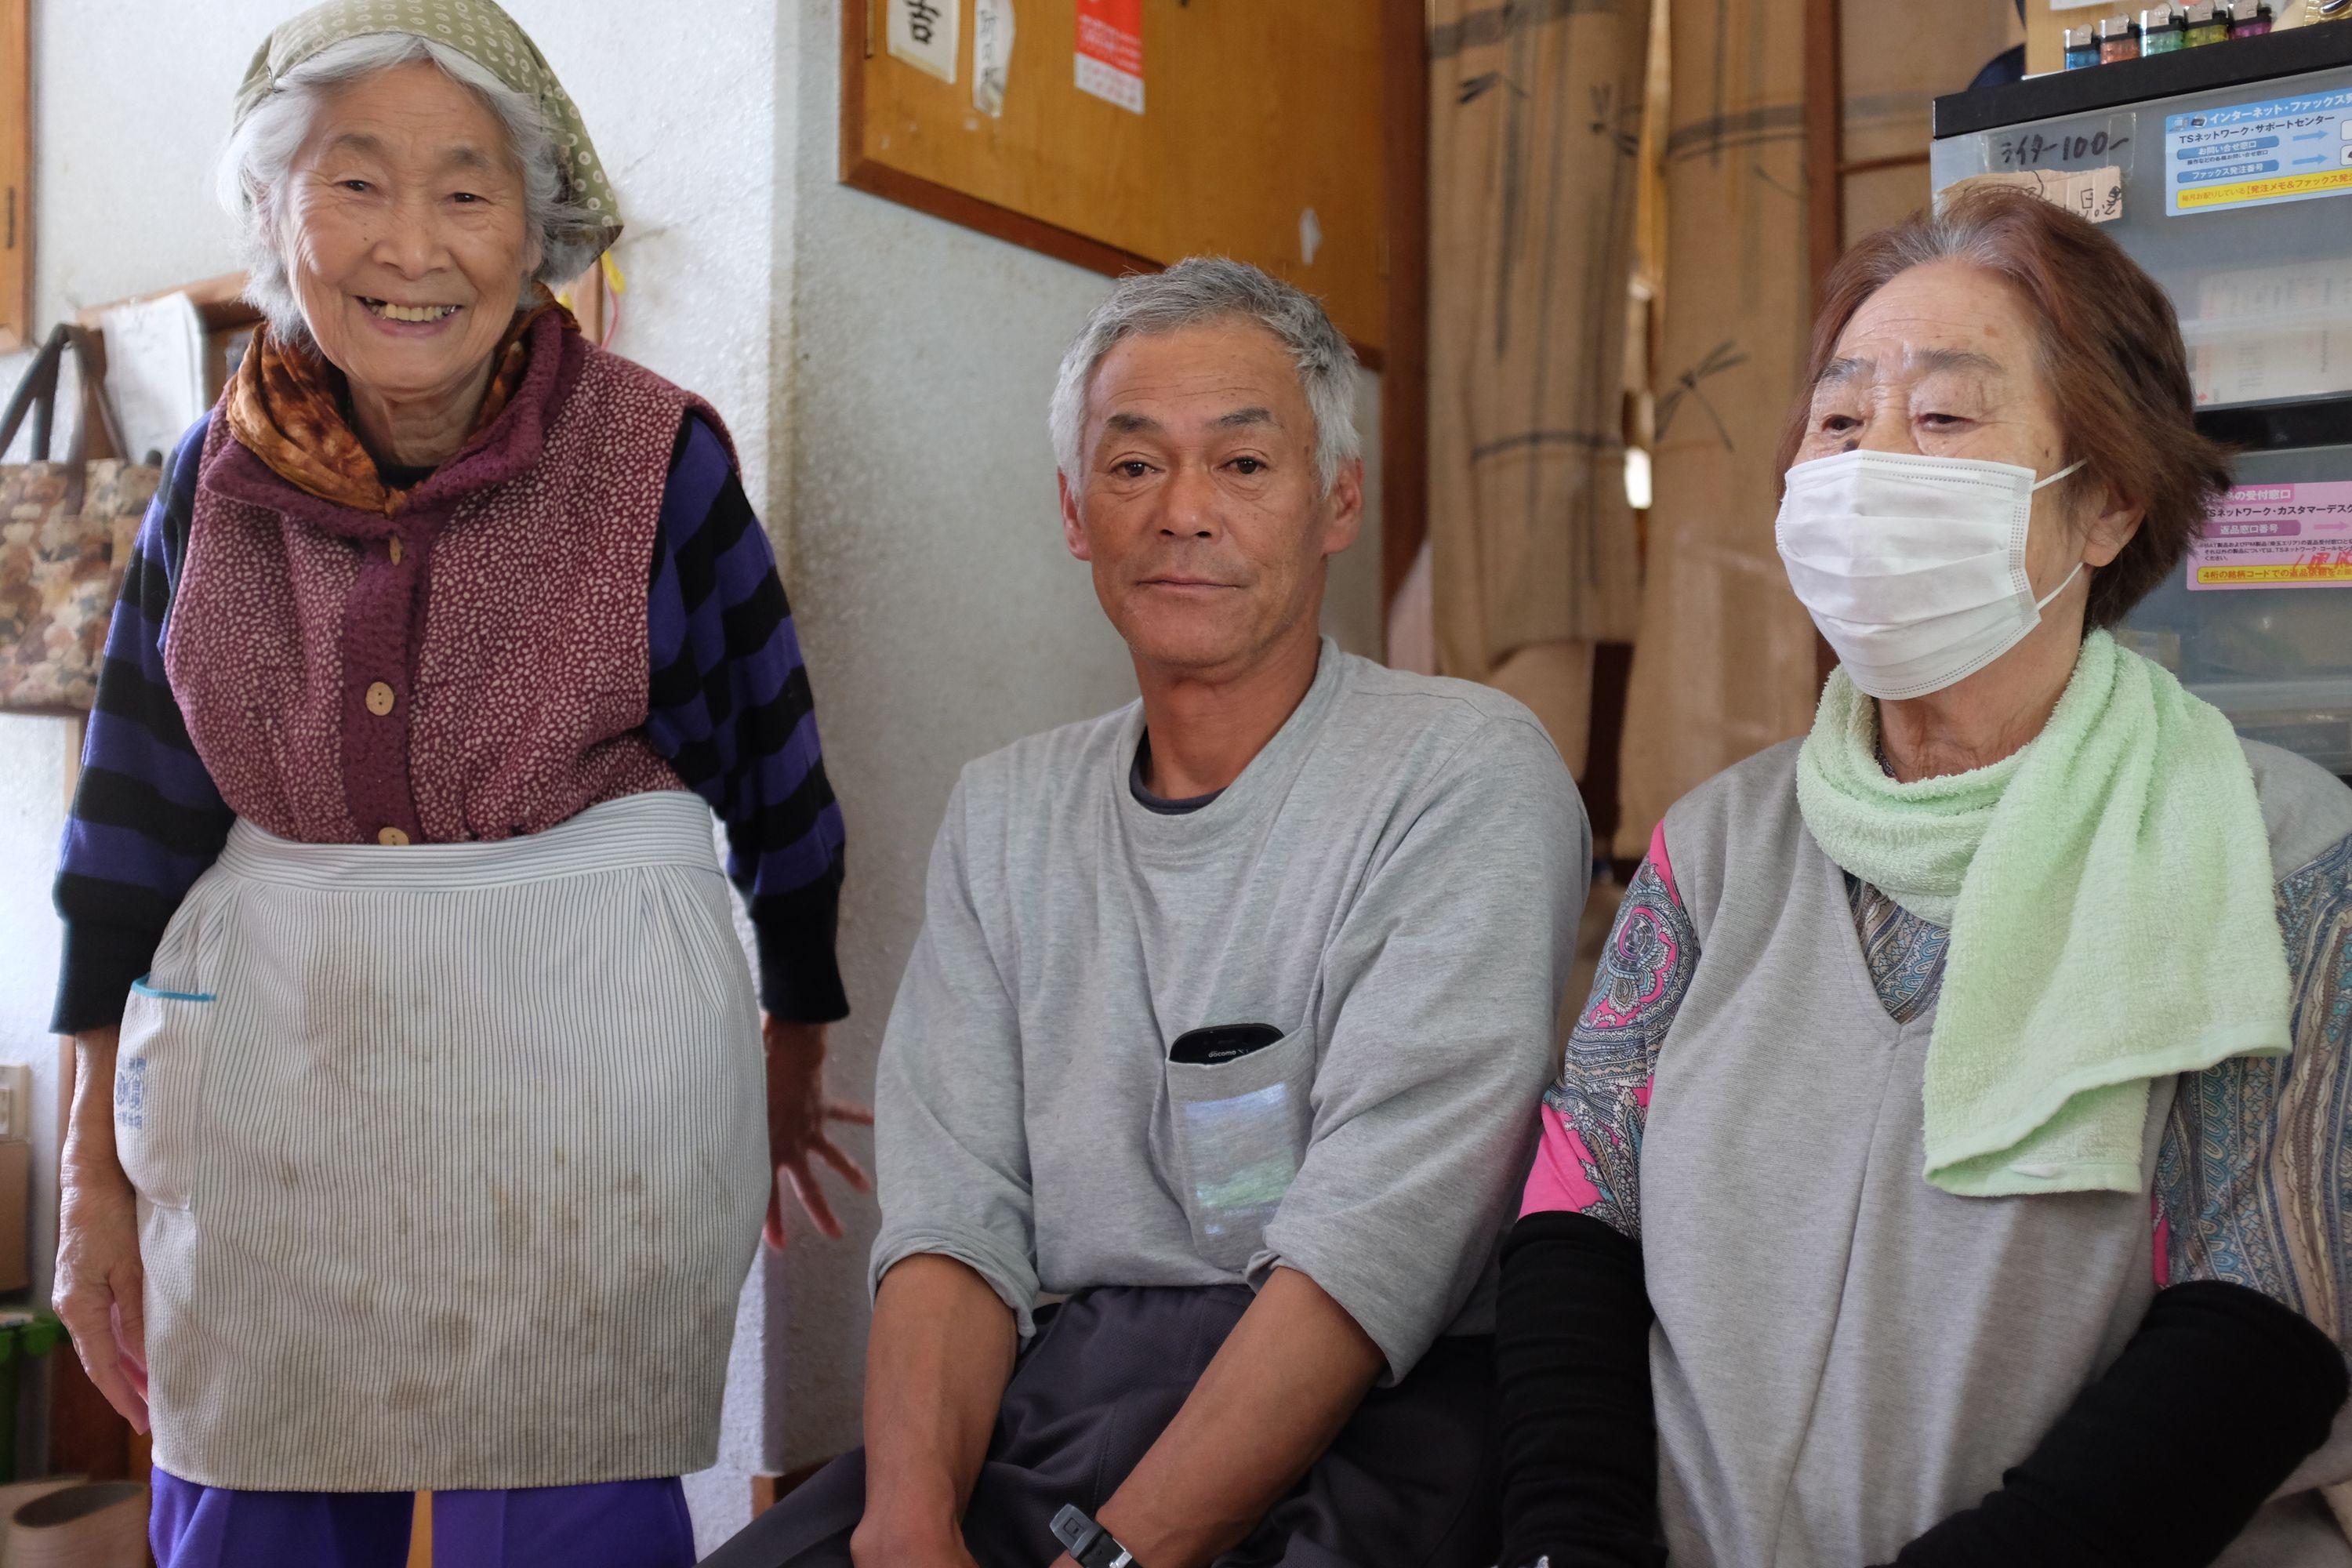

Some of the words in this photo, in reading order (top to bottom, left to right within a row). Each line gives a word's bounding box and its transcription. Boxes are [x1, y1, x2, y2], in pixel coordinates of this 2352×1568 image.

[2179, 115, 2335, 143] TSネットワーク・サポートセンター
[2198, 141, 2257, 155] お問い合せ窓口
[2192, 162, 2264, 180] ファックス発注番号
[2220, 524, 2279, 535] 返品窓口番号
